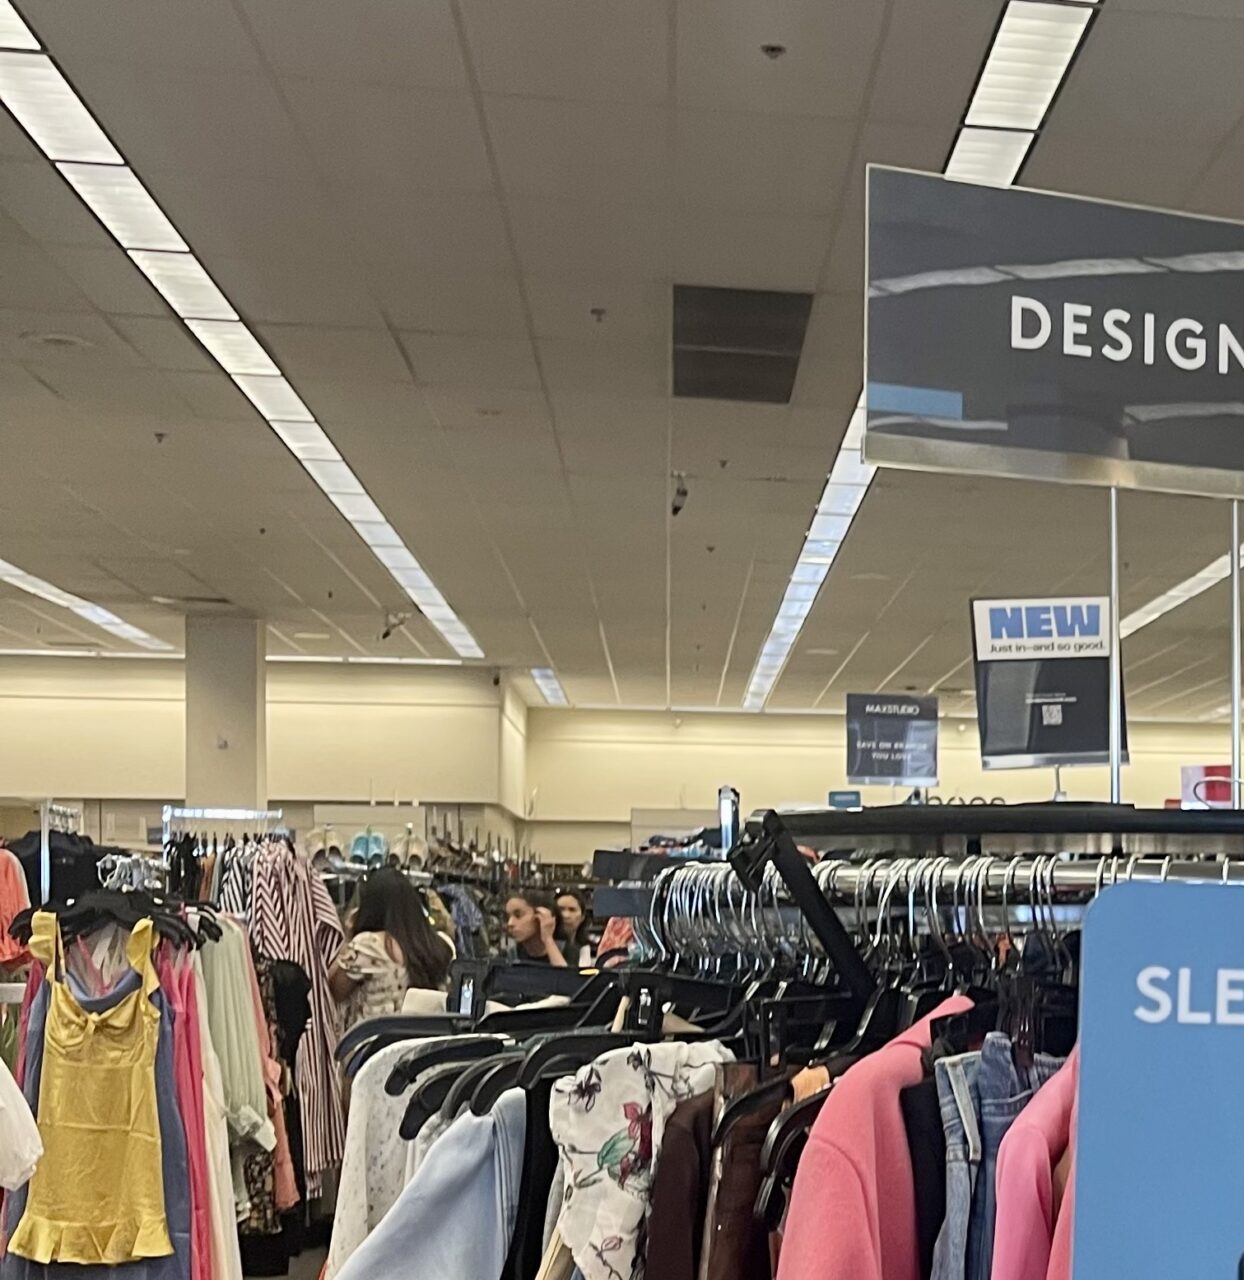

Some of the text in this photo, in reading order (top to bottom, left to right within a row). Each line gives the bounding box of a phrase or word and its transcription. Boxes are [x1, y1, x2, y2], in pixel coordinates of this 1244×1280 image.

[989, 604, 1100, 640] NEW
[990, 643, 1013, 654] Just
[1057, 642, 1071, 652] so
